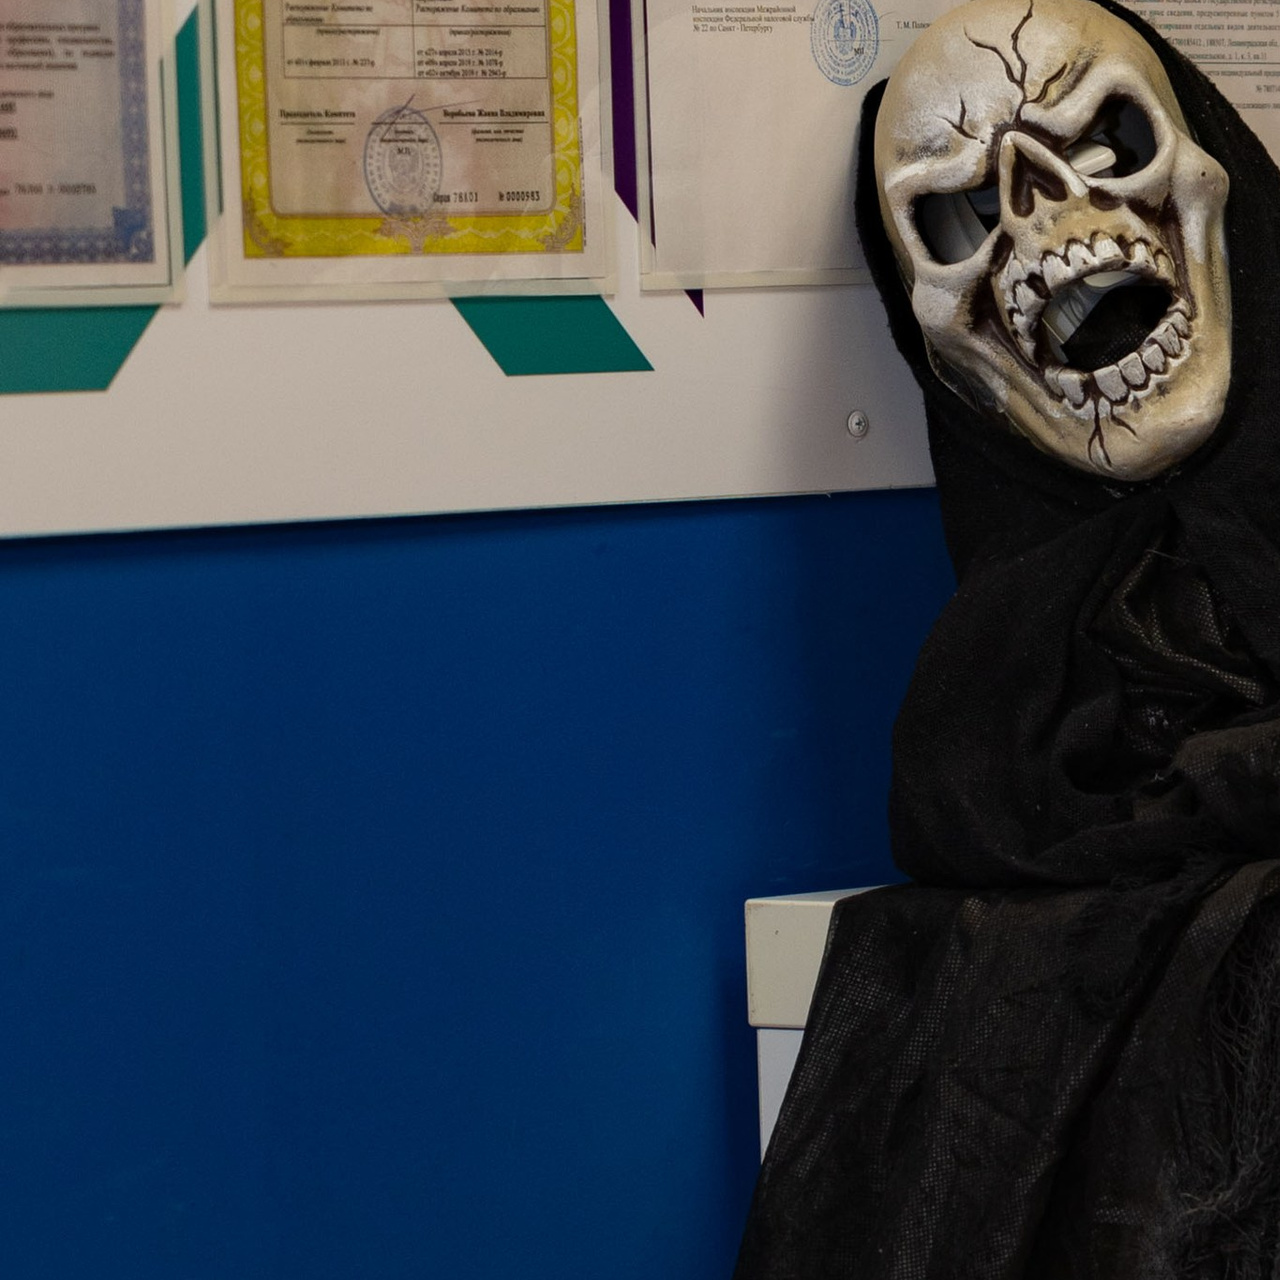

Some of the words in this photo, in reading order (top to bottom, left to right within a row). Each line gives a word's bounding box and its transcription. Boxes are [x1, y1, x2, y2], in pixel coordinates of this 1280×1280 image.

[277, 110, 322, 119] Председатель
[322, 110, 355, 118] Комитета
[442, 110, 476, 118] Воробьева
[476, 109, 498, 118] Жанна
[499, 110, 545, 118] Владимировна
[431, 193, 450, 203] Серия
